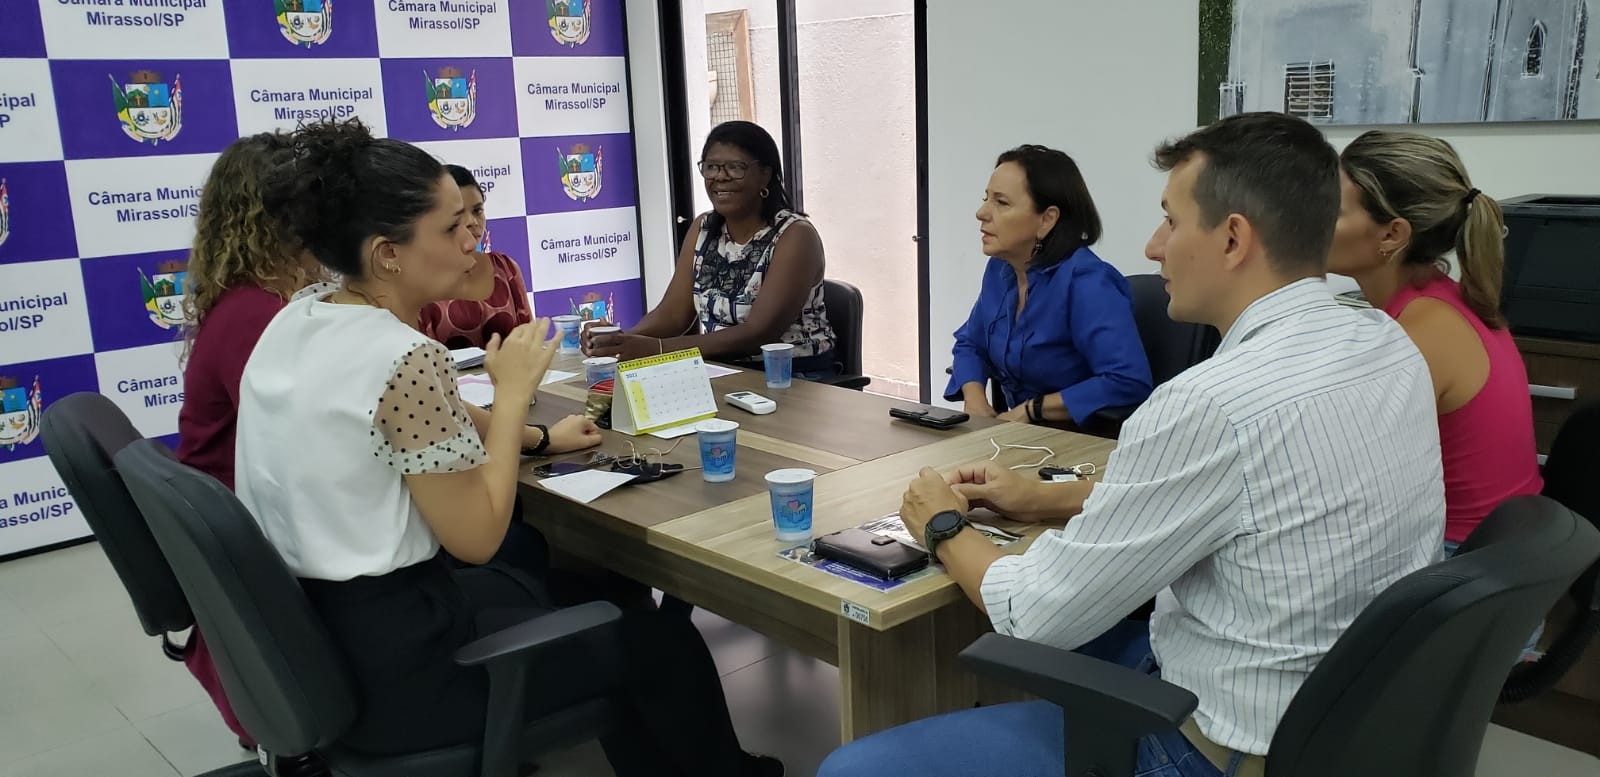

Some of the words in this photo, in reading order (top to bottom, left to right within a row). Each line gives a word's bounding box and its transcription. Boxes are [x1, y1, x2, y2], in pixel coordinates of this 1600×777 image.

[388, 0, 436, 12] Câmara
[439, 0, 497, 15] Municipal
[86, 11, 185, 27] Mirassol/SP
[409, 17, 481, 30] Mirassol/SP
[250, 89, 305, 103] Câmara
[309, 87, 373, 103] Municipal
[527, 83, 569, 95] Câmara
[571, 82, 620, 96] Municipal
[545, 98, 607, 111] Mirassol/SP
[274, 105, 355, 120] Mirassol/SP
[470, 164, 511, 179] nicipal
[88, 191, 152, 206] Câmara
[117, 203, 202, 223] Mirassol/S
[541, 238, 581, 251] Câmara
[584, 231, 631, 246] Municipal
[558, 247, 618, 264] Mirassol/SP
[117, 375, 178, 394] Câmara
[13, 486, 69, 506] Munic
